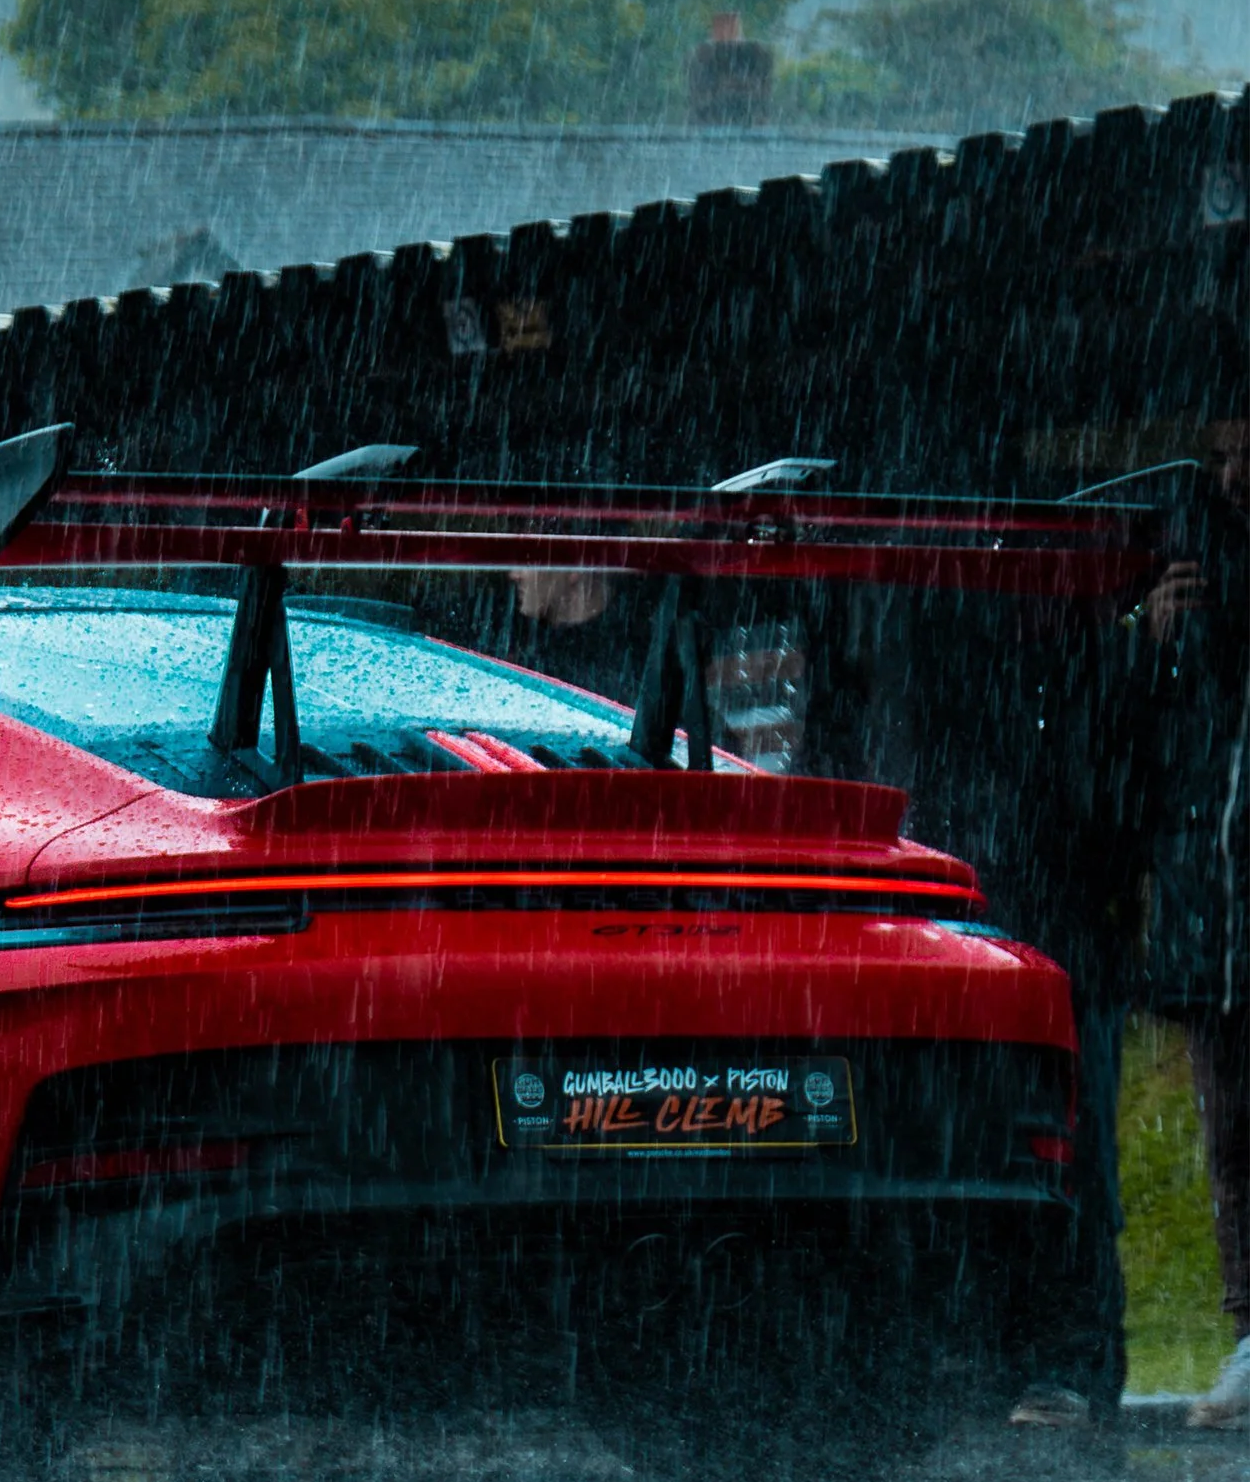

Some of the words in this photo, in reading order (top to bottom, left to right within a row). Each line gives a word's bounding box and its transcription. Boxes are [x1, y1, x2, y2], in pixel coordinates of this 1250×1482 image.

[727, 1066, 789, 1092] PISTON
[562, 1096, 651, 1134] HILL
[654, 1095, 786, 1135] CLIMB
